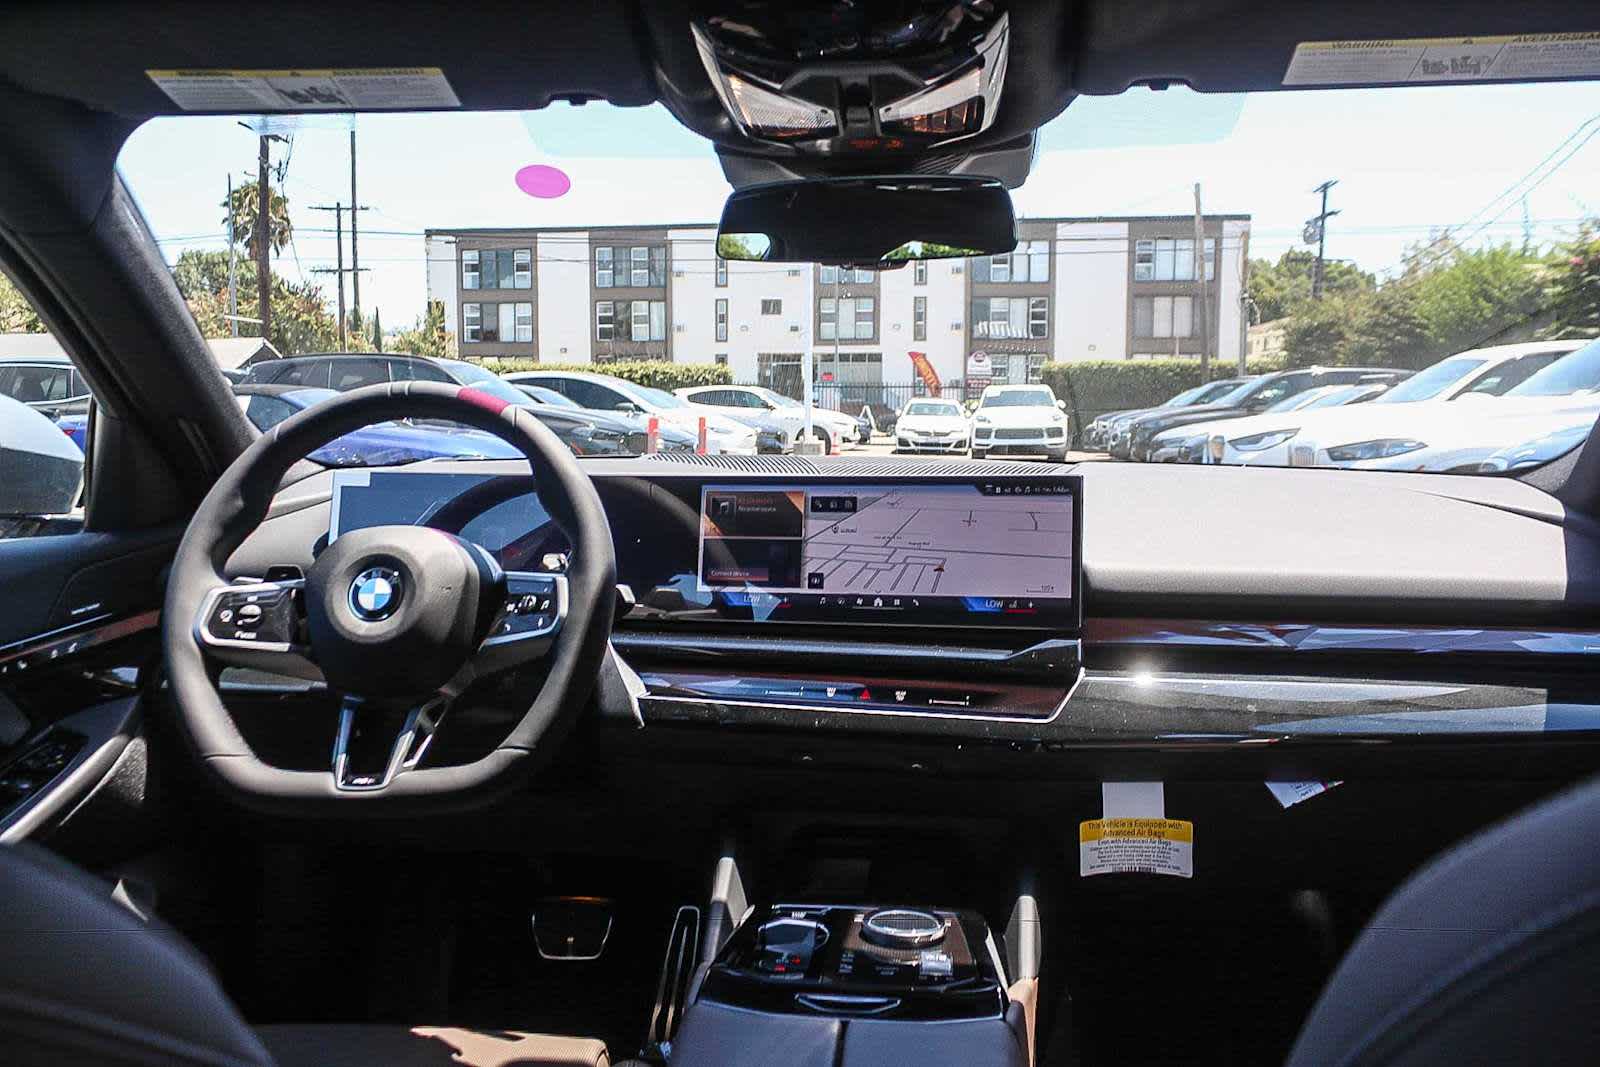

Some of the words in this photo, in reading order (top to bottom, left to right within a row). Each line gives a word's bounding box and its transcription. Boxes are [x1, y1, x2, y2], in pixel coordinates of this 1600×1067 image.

[985, 600, 1004, 609] LOW
[1088, 822, 1101, 830] This
[1101, 821, 1126, 829] Vehicle
[1134, 820, 1167, 830] Equipped
[1168, 821, 1183, 830] with
[1103, 829, 1136, 837] Advanced
[1136, 828, 1147, 837] Air
[1148, 829, 1165, 838] Bags
